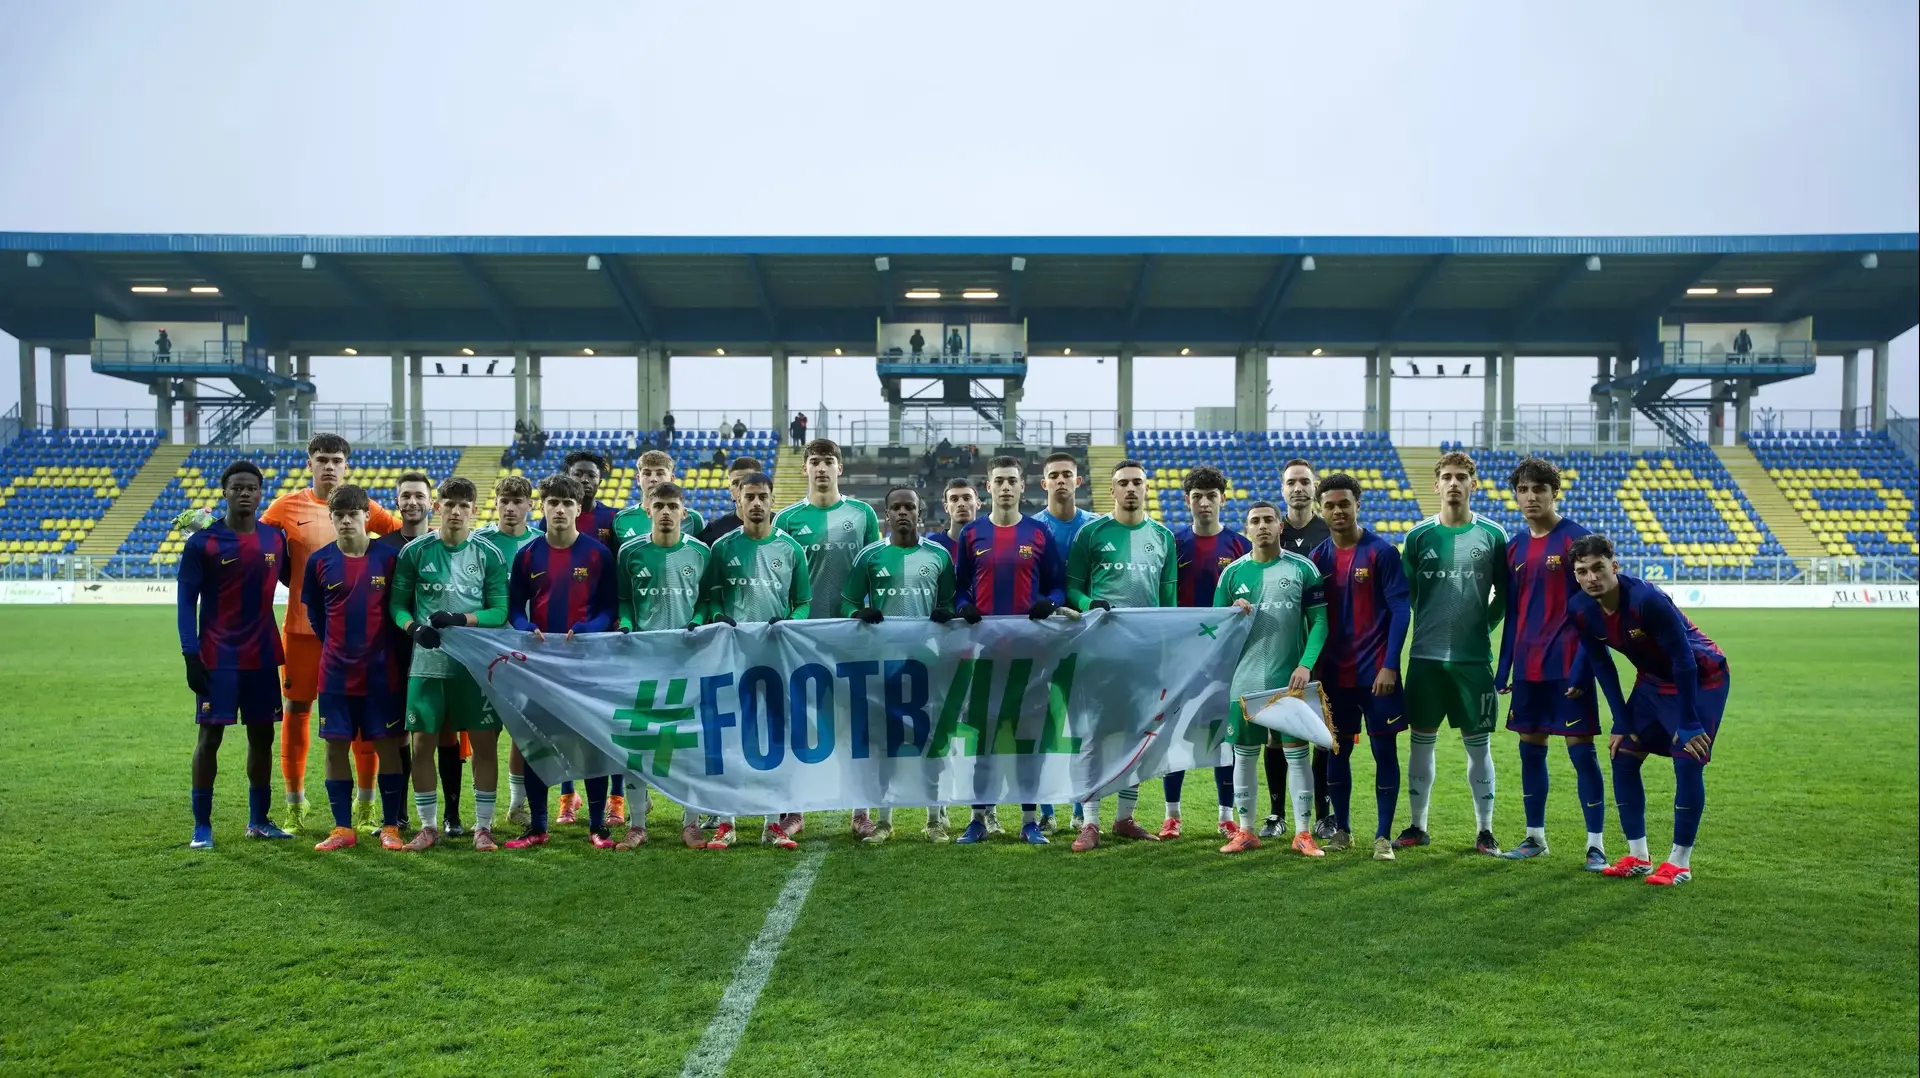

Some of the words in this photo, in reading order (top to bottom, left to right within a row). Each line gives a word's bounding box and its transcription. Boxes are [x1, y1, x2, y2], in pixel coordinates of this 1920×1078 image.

[802, 542, 857, 553] VOLVO
[1101, 562, 1157, 573] VOLVO
[1422, 570, 1484, 580] VOLVO
[727, 577, 783, 589] VOLVO
[421, 583, 479, 595] VOLVO
[638, 587, 693, 596] VOLVO
[876, 588, 931, 596] VOLVO
[1480, 692, 1495, 715] 17
[610, 652, 1083, 778] #FOOTBALL
